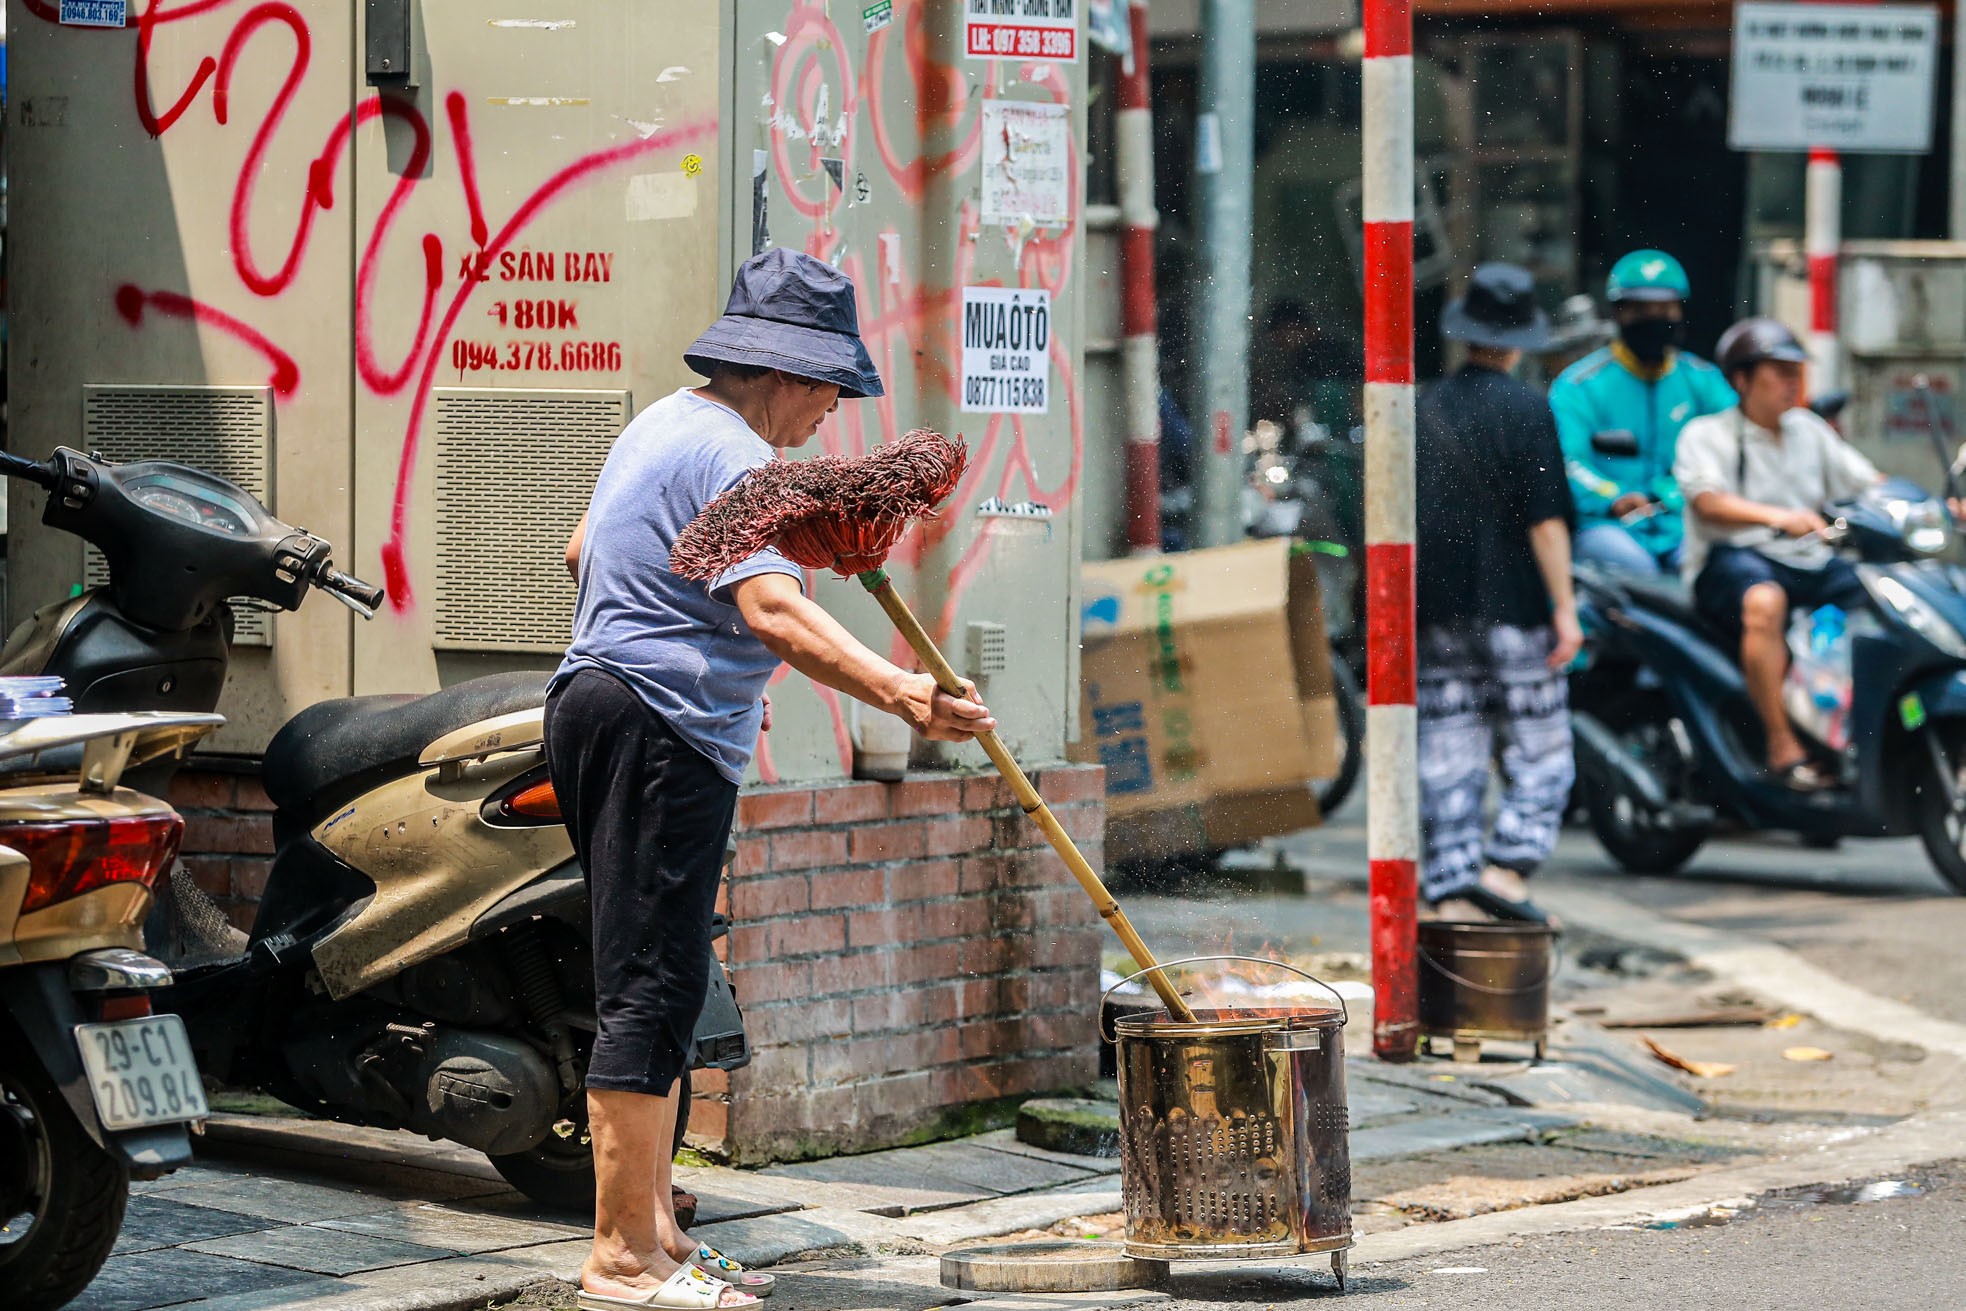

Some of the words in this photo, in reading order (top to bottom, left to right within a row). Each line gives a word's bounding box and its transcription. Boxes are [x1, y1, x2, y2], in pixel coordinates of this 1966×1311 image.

[565, 252, 614, 282] BAY
[487, 299, 580, 330] 180K
[453, 339, 621, 373] 094.378.6686
[96, 1024, 176, 1073] 29-C1
[101, 1071, 198, 1120] 209.84
